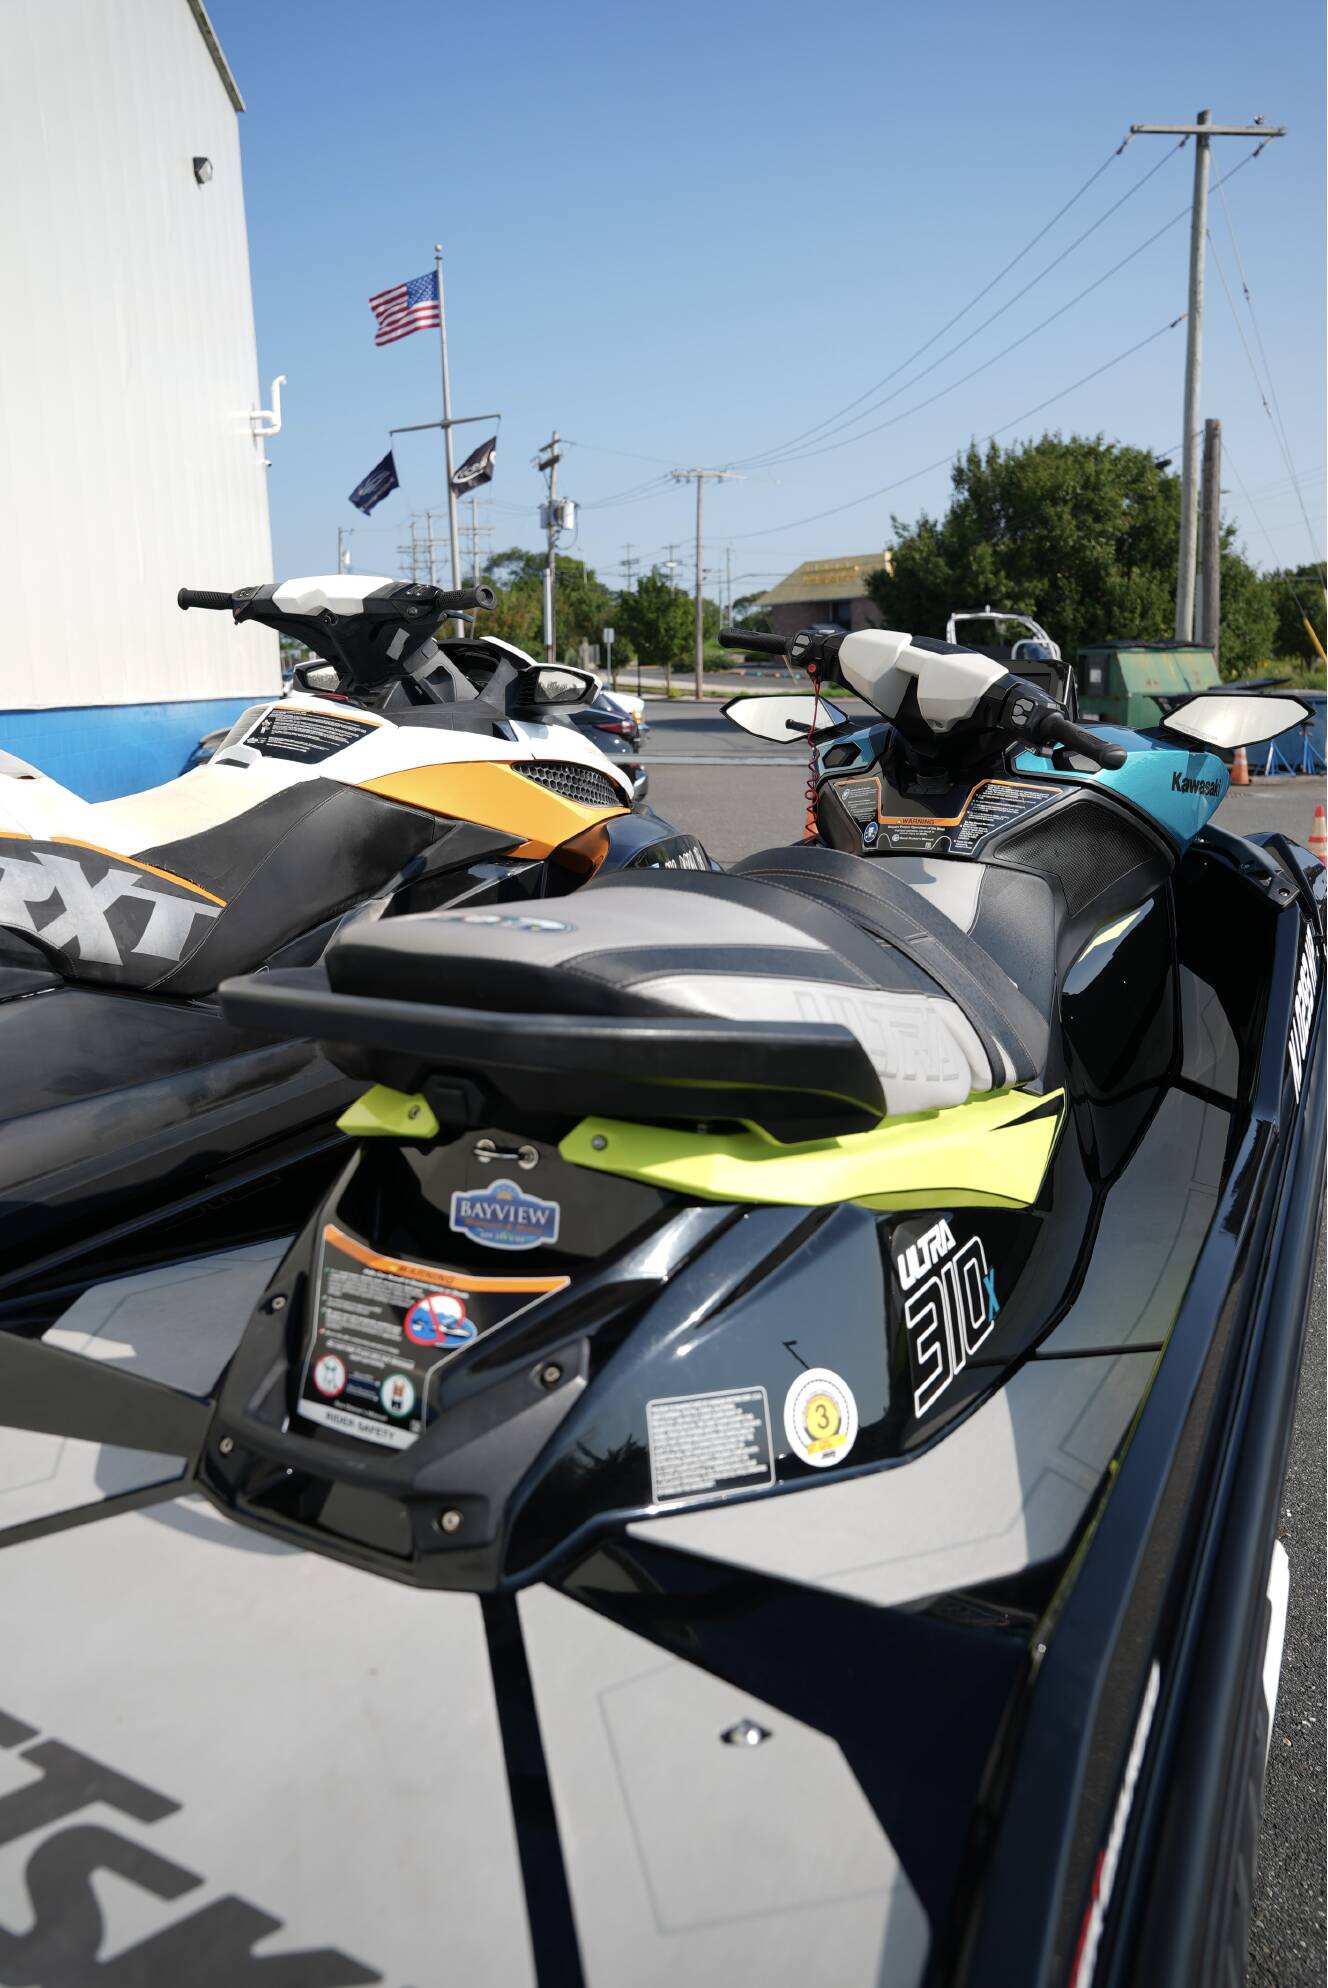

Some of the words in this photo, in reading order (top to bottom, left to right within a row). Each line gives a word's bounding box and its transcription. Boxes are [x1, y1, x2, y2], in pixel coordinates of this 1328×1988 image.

[1171, 771, 1222, 797] Kawasaki
[460, 1200, 550, 1225] BAYVIEW
[897, 1219, 957, 1291] ULTRA
[815, 1404, 830, 1430] 3
